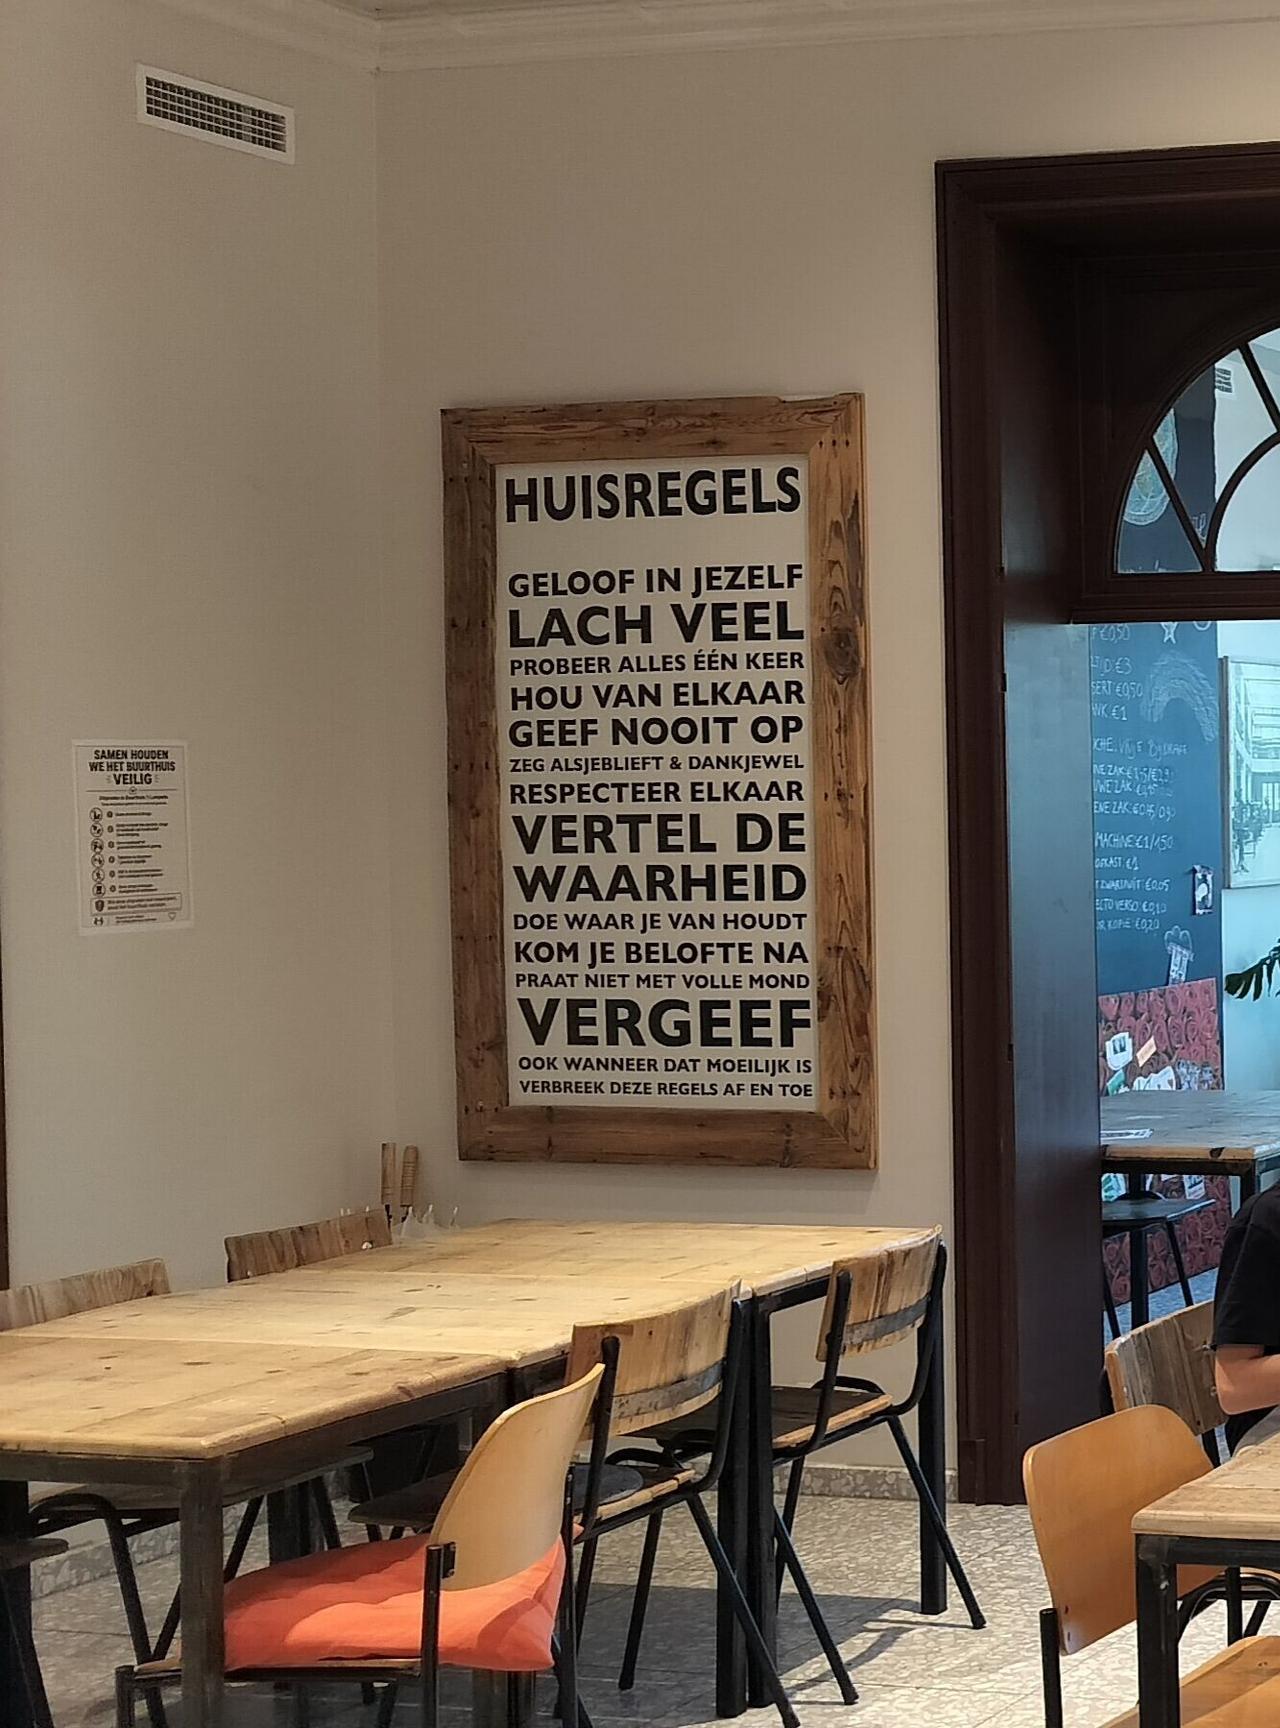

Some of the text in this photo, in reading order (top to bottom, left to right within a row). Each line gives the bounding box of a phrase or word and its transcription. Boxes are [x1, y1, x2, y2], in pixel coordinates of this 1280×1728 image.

[506, 467, 800, 522] HUISREGELS
[509, 564, 802, 598] GELOOF IN JEZELF
[509, 601, 804, 648] LACH VEEL
[511, 649, 804, 676] PROBEER ALLES ÉÉN KEER
[511, 681, 805, 710] HOU VAN ELKAAR
[509, 716, 803, 747] GEEF NOOIT OP
[89, 761, 175, 771] WE HET BUURTHUIS
[94, 750, 169, 760] SAMEN HOUDEN
[510, 755, 804, 775] ZEG ALSJEBLIEFT & DANKJEWEL
[114, 774, 152, 784] VEILIG
[510, 781, 804, 804] RESPECTEER ELKAAR
[512, 813, 805, 854] VERTEL DE
[513, 864, 806, 902] WAARHEID
[514, 913, 807, 934] DOE WAAR JE VAN HOUDT
[515, 942, 808, 969] KOM JE BELOFTE NA
[516, 974, 809, 988] PRAAT NIET MET VOLLE MOND
[517, 998, 811, 1047] VERGEEF
[519, 1057, 811, 1077] OOK WANNEER DAT MOEILIJK IS
[520, 1081, 812, 1096] VERBREEK DEZE REGELS AF EN TOE
